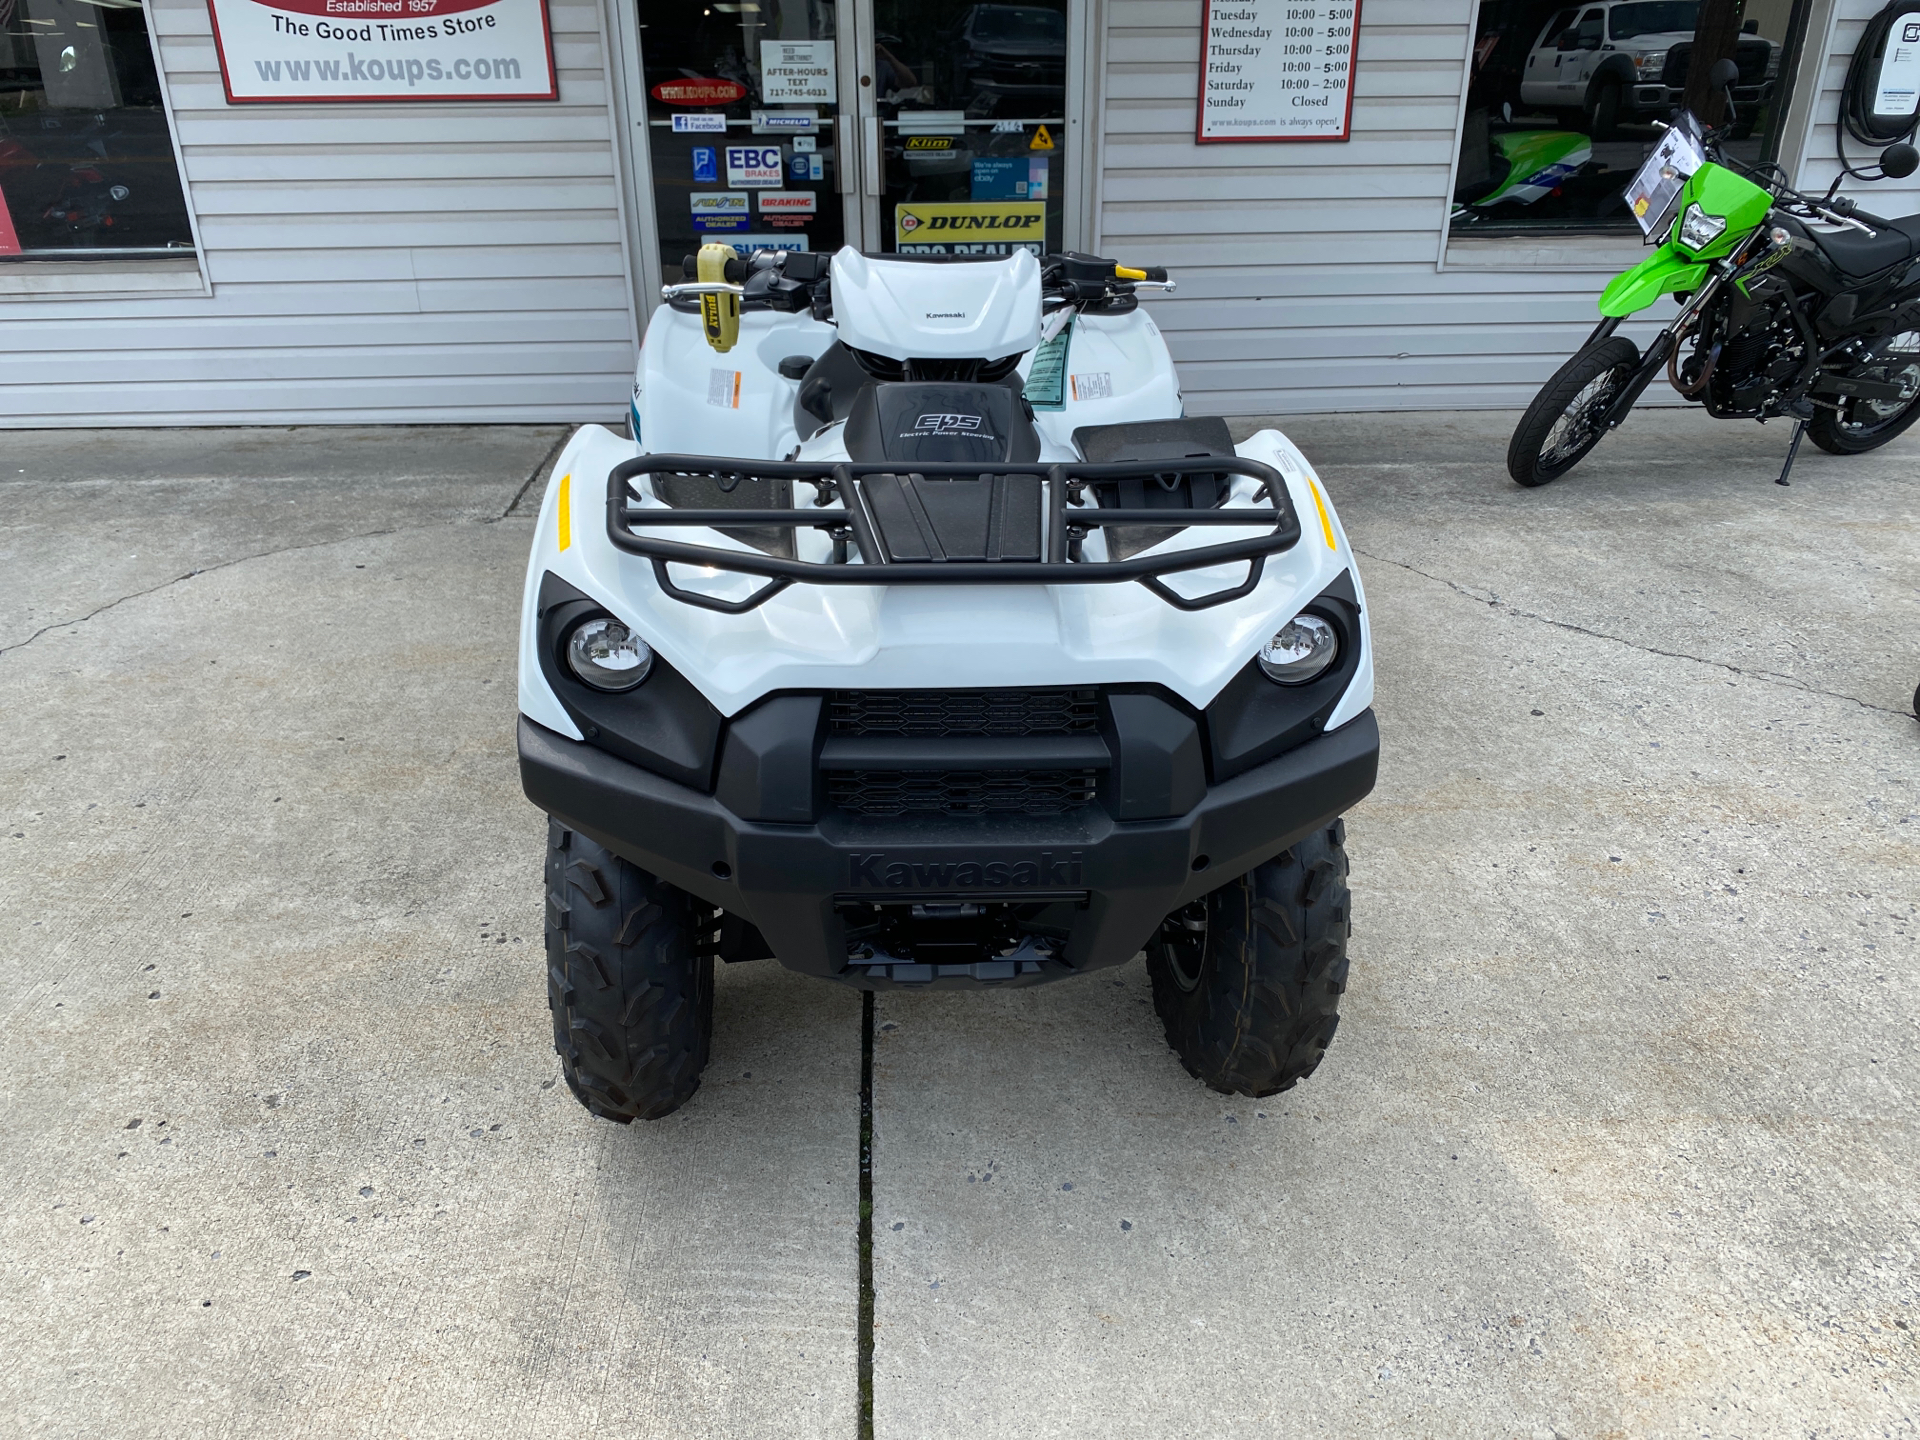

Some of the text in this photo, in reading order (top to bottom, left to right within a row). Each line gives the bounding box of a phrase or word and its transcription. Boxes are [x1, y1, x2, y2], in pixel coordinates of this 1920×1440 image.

[326, 0, 437, 12] Established 1957
[1212, 9, 1258, 23] Tuesday
[1286, 9, 1315, 20] 10:00
[1328, 9, 1353, 20] 5:00
[271, 14, 496, 42] The Good Times Store
[1211, 27, 1272, 39] Wednesday
[1284, 27, 1314, 38] 10:00
[1327, 27, 1351, 38] 5:00
[1209, 45, 1261, 57] Thursday
[1283, 44, 1312, 55] 10:00
[1325, 44, 1350, 56] 5:00
[254, 52, 521, 87] www.koups.com
[767, 68, 828, 76] AFTER-HOURS
[1208, 62, 1242, 75] Friday
[1281, 62, 1311, 72] 10:00
[1323, 61, 1348, 73] 5:00
[787, 78, 808, 86] TEXT
[1207, 79, 1255, 92] Saturday
[1280, 79, 1310, 89] 10:00
[1323, 78, 1346, 89] 2:00
[660, 86, 738, 99] WWW.KOUPS.COM
[1206, 95, 1328, 109] Sunday Closed
[691, 121, 723, 129] Facebook
[1211, 117, 1337, 129] www.koups.com is always open!
[729, 149, 779, 169] EBC
[745, 169, 780, 178] BRAKES
[761, 198, 811, 207] BRAKING
[927, 215, 1042, 230] DUNLOP
[706, 295, 719, 328] BULLY
[914, 413, 982, 431] EPS
[900, 430, 930, 438] Electric
[961, 431, 995, 440] Steering
[849, 851, 1083, 888] Kawasaki
